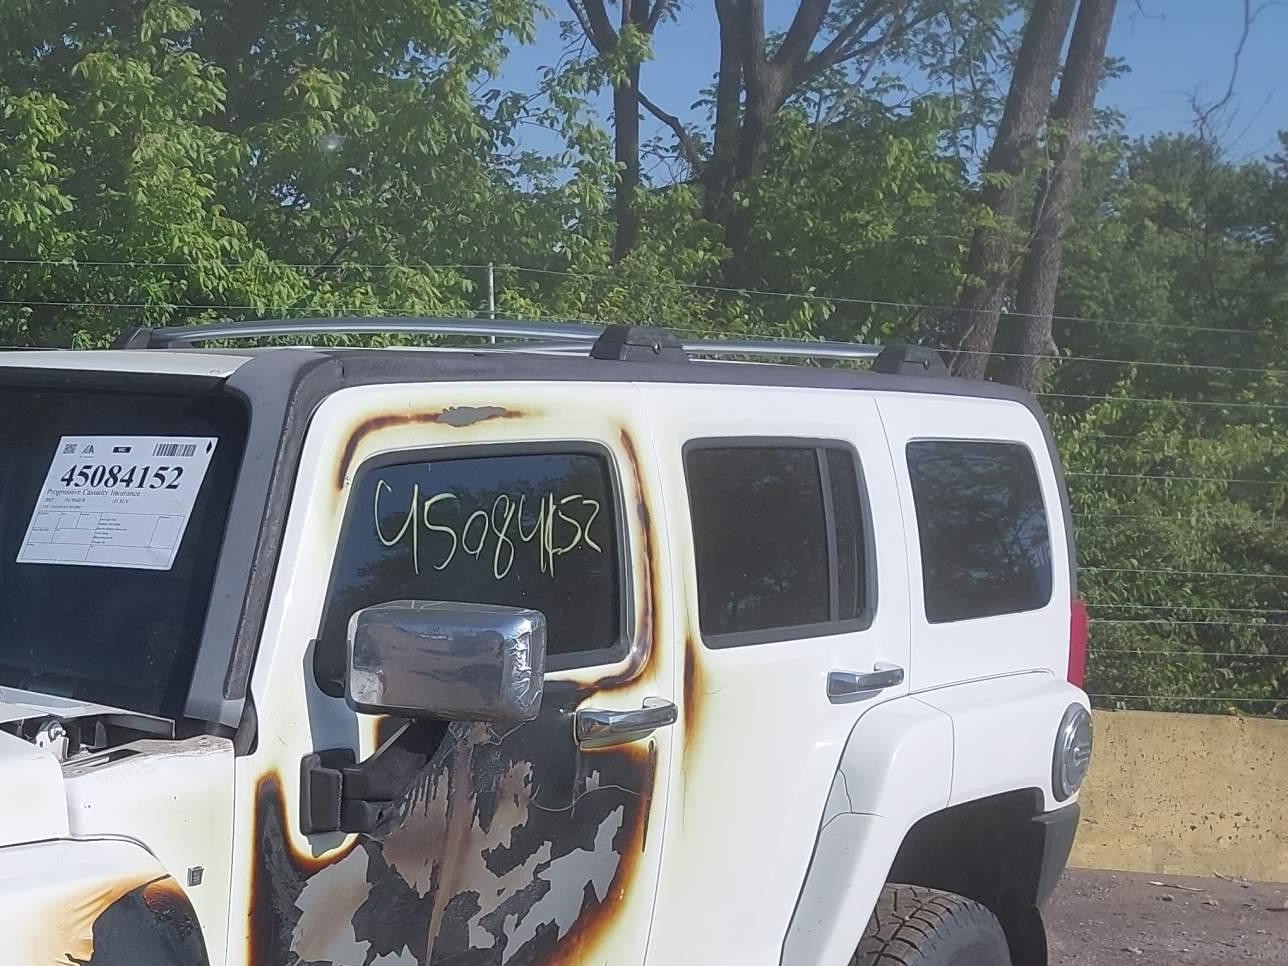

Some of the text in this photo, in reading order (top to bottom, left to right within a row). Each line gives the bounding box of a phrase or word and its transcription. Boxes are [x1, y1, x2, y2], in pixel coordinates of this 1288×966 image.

[60, 464, 184, 490] 45084152
[46, 488, 141, 498] Progressive Casualty Insurance
[374, 478, 602, 580] 45084152
